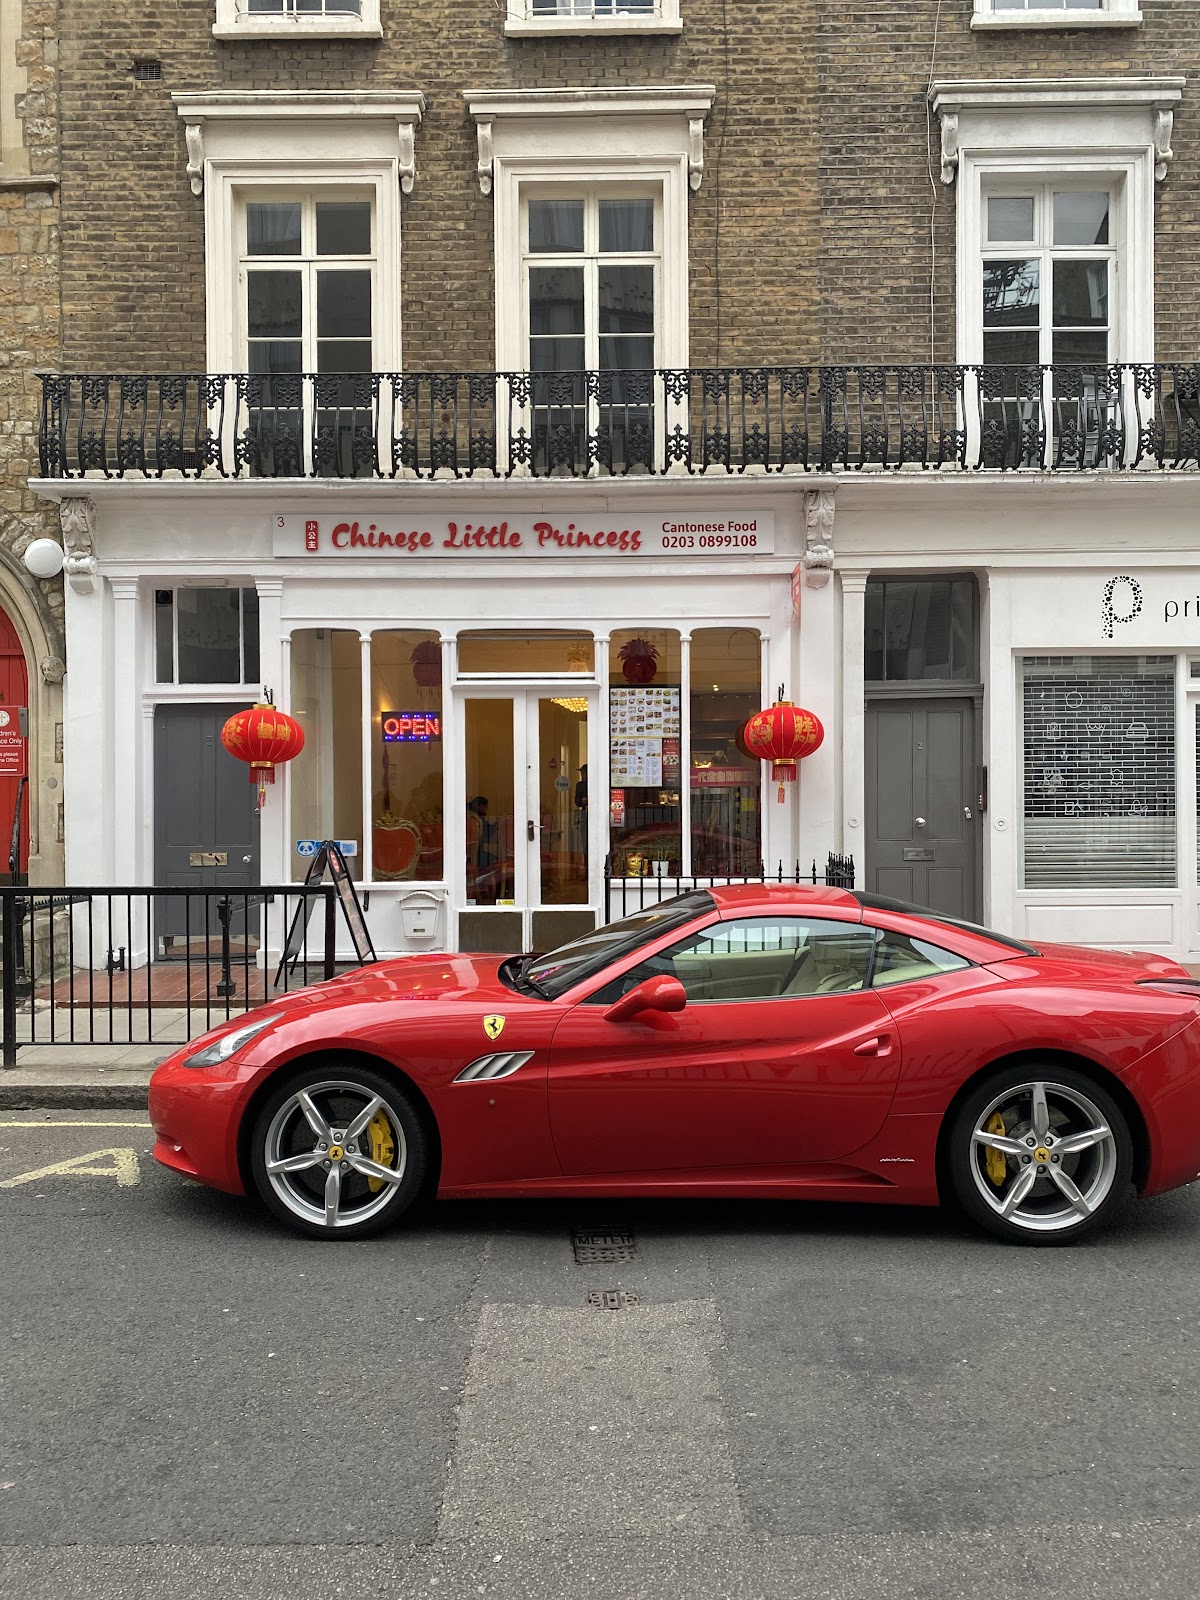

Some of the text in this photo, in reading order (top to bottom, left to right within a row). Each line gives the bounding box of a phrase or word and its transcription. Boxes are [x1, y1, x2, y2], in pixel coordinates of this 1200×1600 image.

[277, 516, 285, 528] 3
[661, 519, 757, 533] Cantonese Food
[307, 522, 317, 549] 小公主
[331, 521, 643, 551] Chinese Little Princess
[661, 534, 757, 548] 0203 0899108
[1164, 595, 1200, 623] pri
[383, 718, 440, 736] OPEN
[576, 1234, 632, 1245] METER
